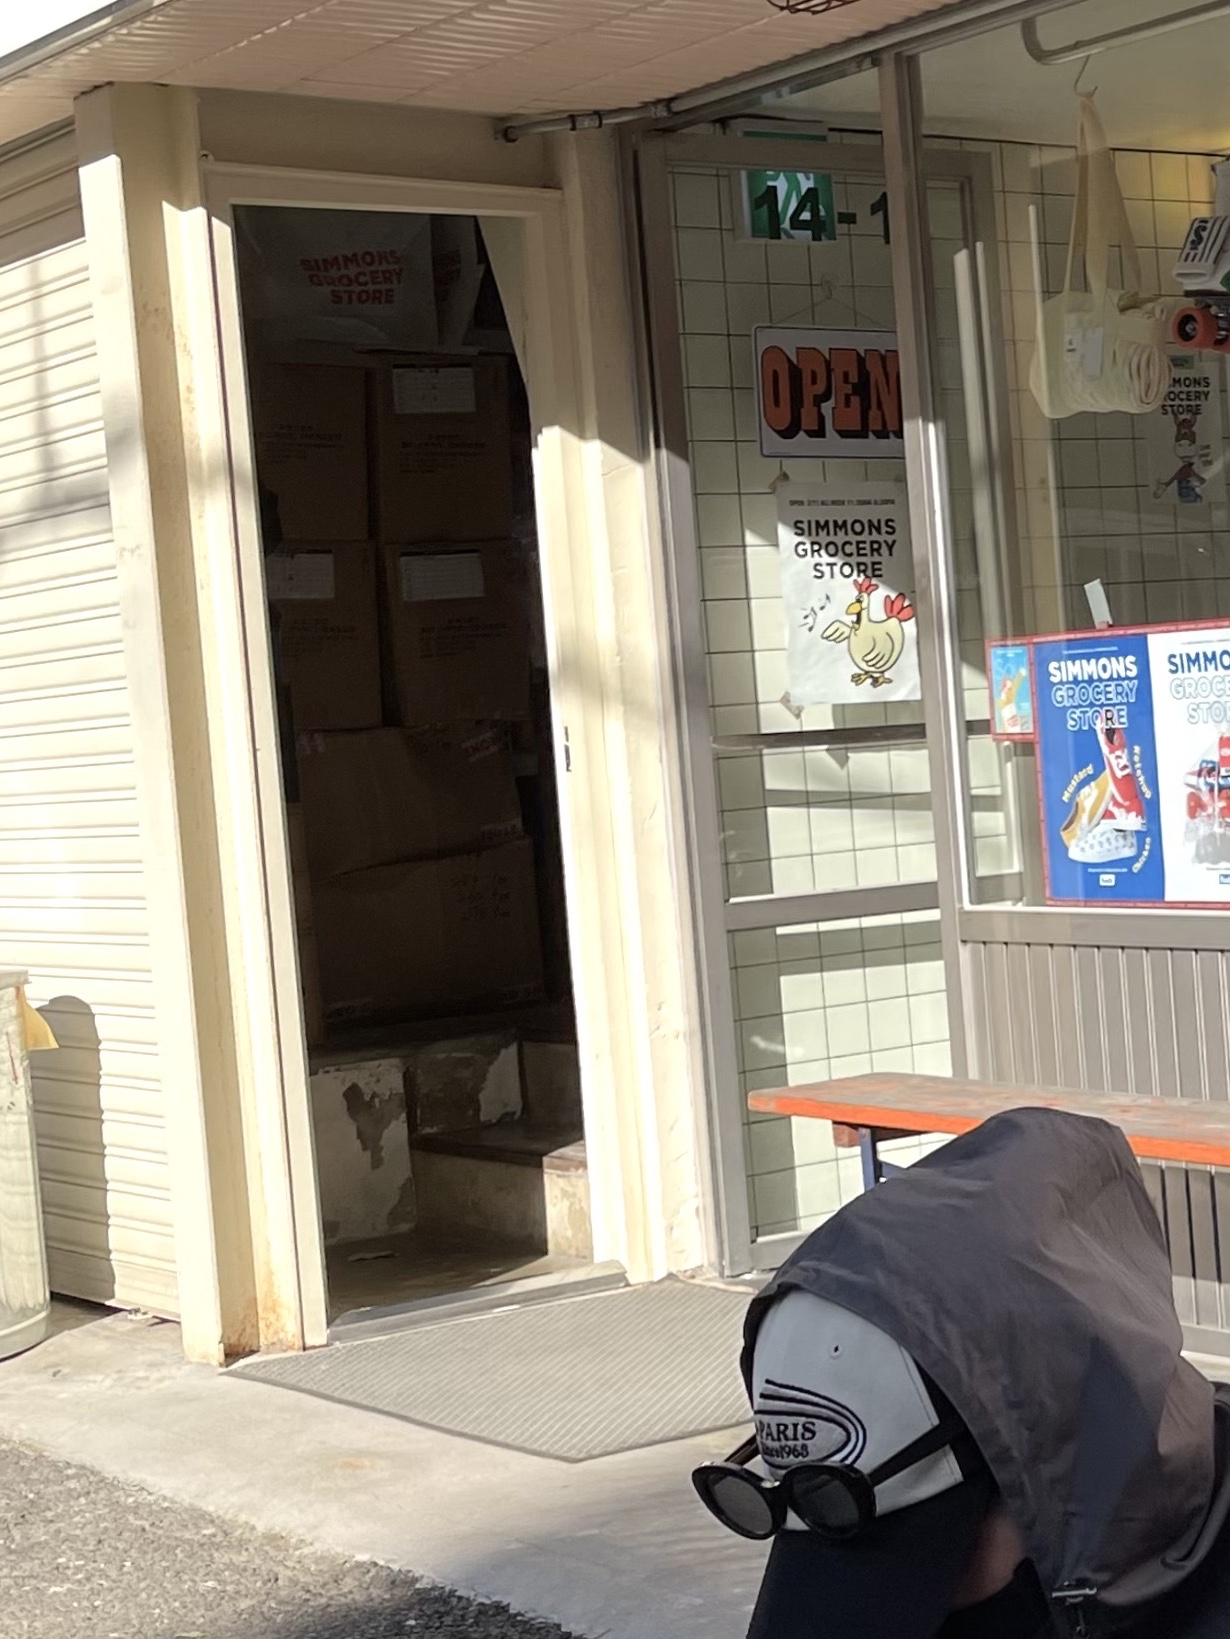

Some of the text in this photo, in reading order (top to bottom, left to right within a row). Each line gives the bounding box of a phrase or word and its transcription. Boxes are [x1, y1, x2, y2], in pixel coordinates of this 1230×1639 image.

[300, 250, 403, 273] SIMMONS
[308, 268, 404, 287] GROCERY
[330, 288, 395, 305] STORE
[1169, 376, 1211, 389] MONS
[761, 345, 903, 440] OPEN
[1165, 390, 1211, 402] OCERY
[1161, 404, 1203, 416] STORE
[793, 518, 896, 537] SIMMONS
[794, 539, 897, 558] GROCERY
[813, 561, 883, 579] STORE
[1048, 655, 1137, 683] SIMMONS
[1051, 680, 1138, 707] GROCERY
[1066, 705, 1128, 731] STORE
[759, 1420, 817, 1442] PARIS
